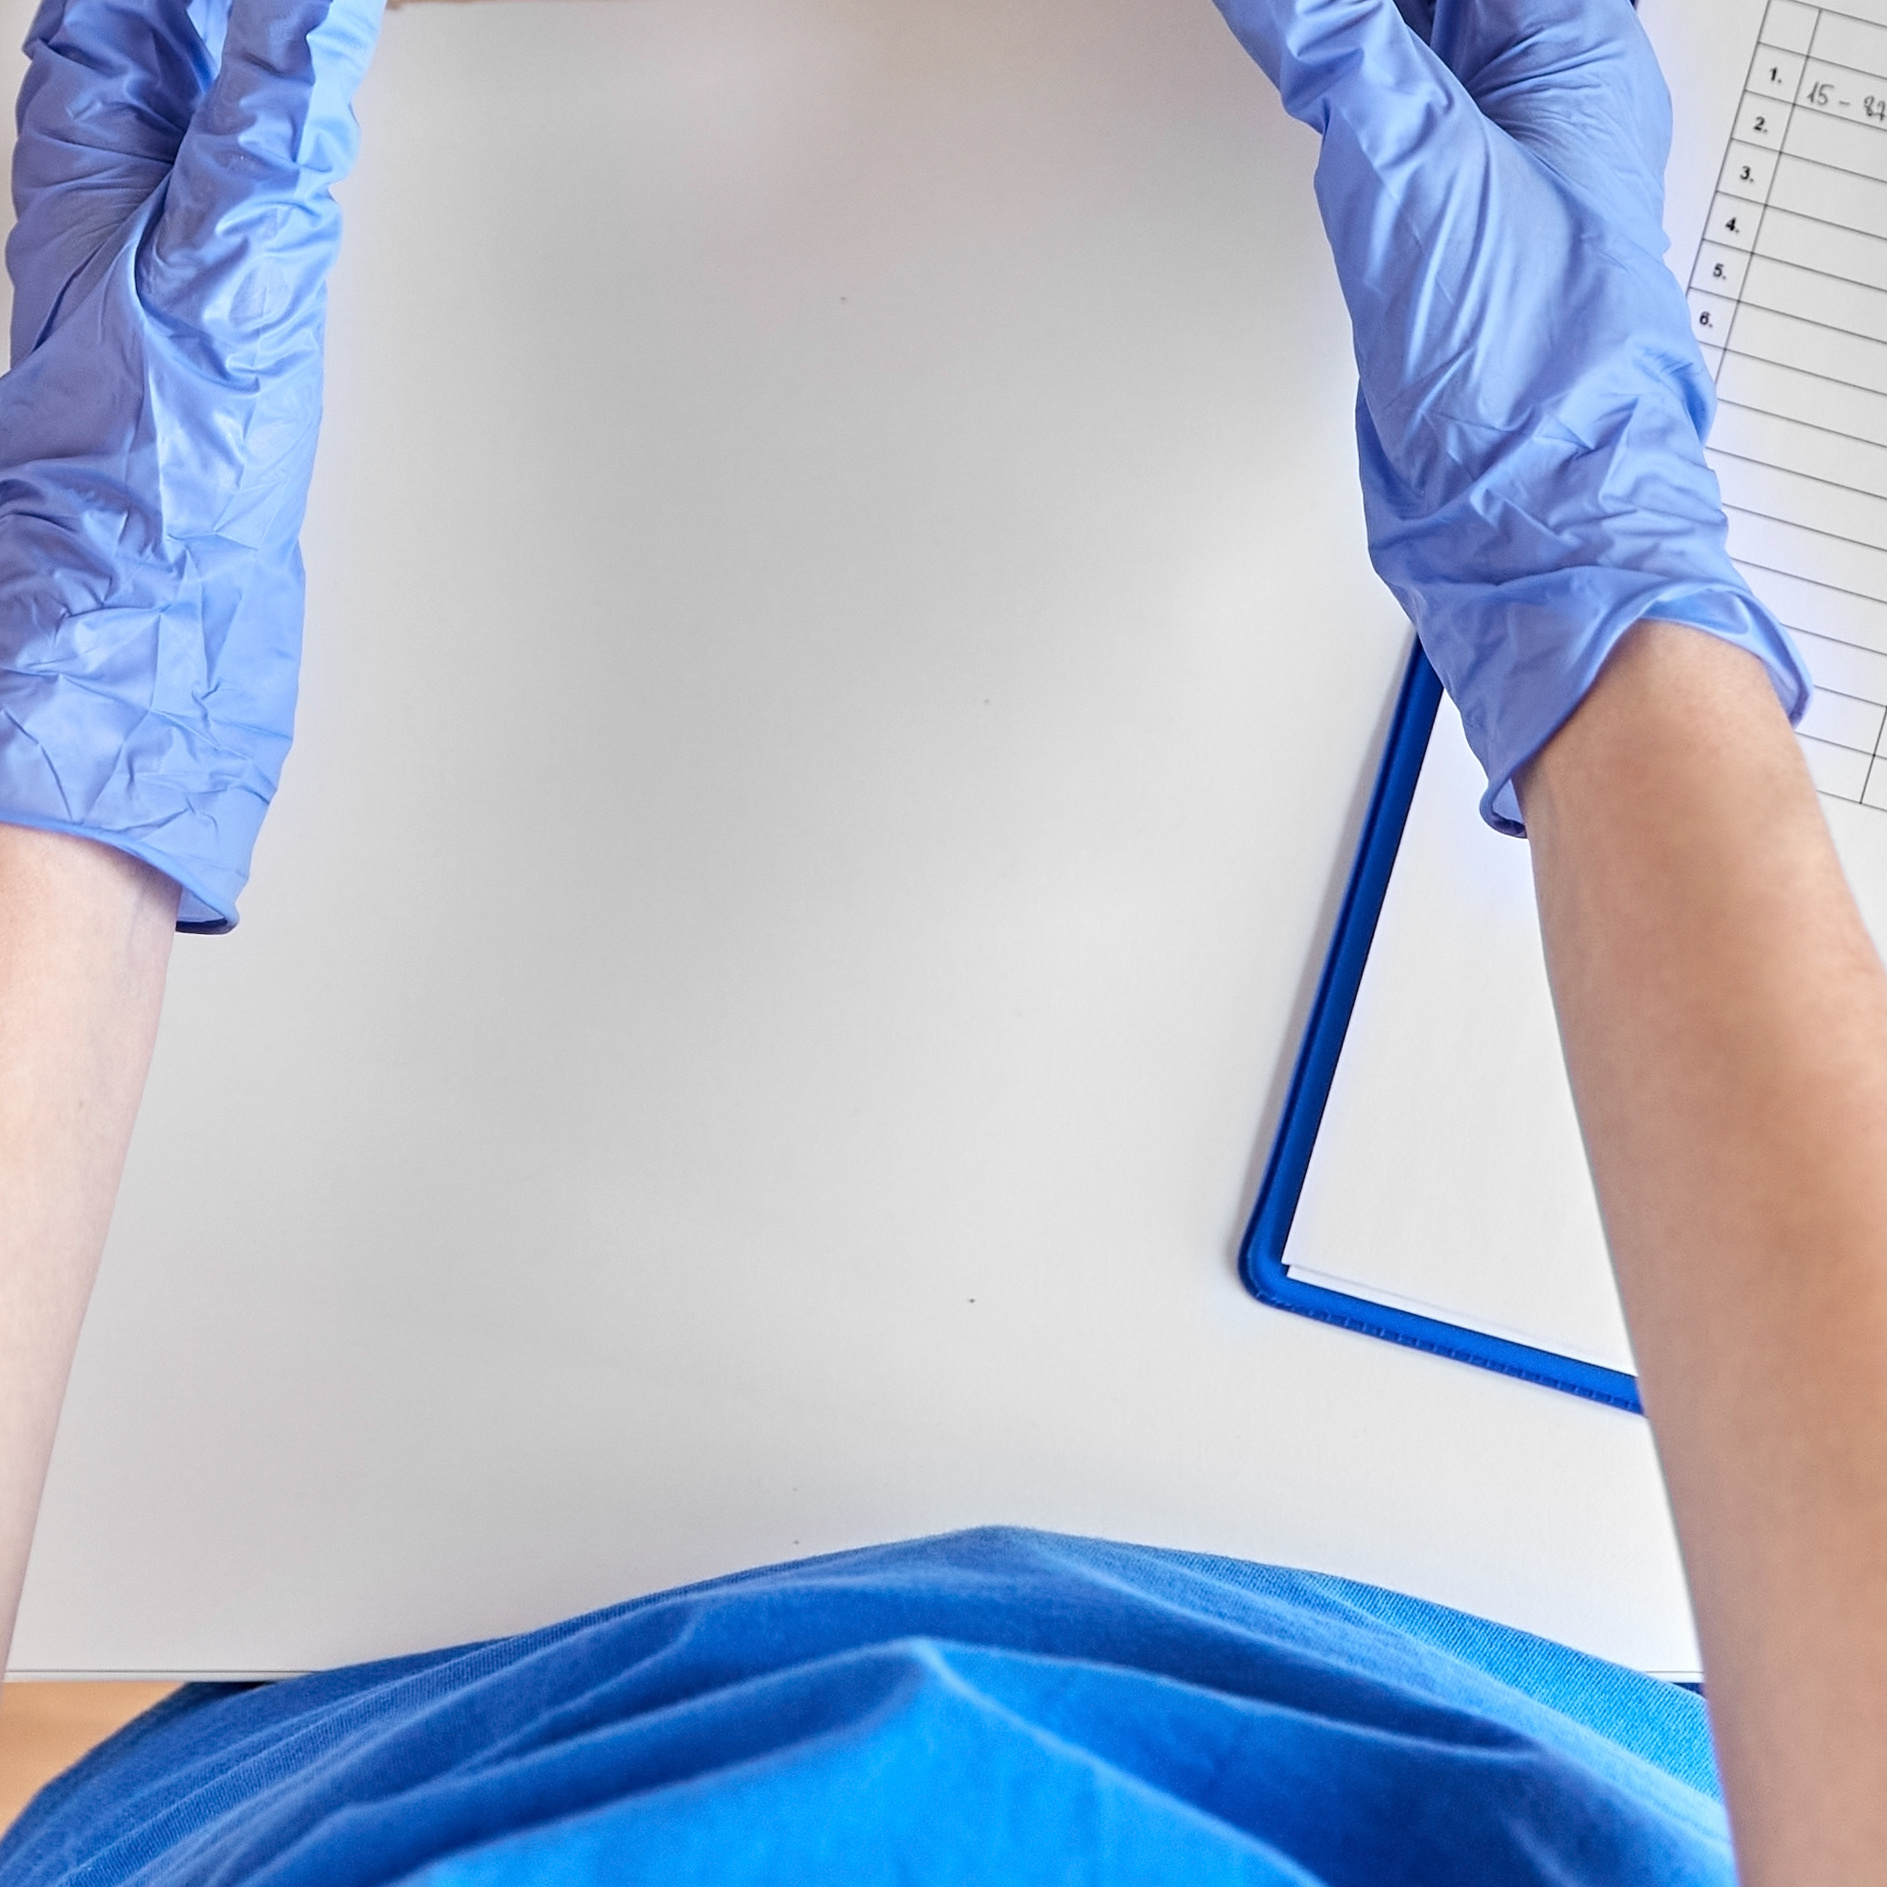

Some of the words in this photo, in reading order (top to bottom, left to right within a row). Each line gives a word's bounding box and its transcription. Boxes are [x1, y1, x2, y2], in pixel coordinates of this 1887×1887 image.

[1769, 66, 1782, 84] 1.
[1753, 116, 1768, 134] 2.
[1739, 165, 1754, 183] 3.
[1725, 216, 1740, 233] 4.
[1712, 262, 1726, 280] 5.
[1698, 310, 1713, 328] 6.
